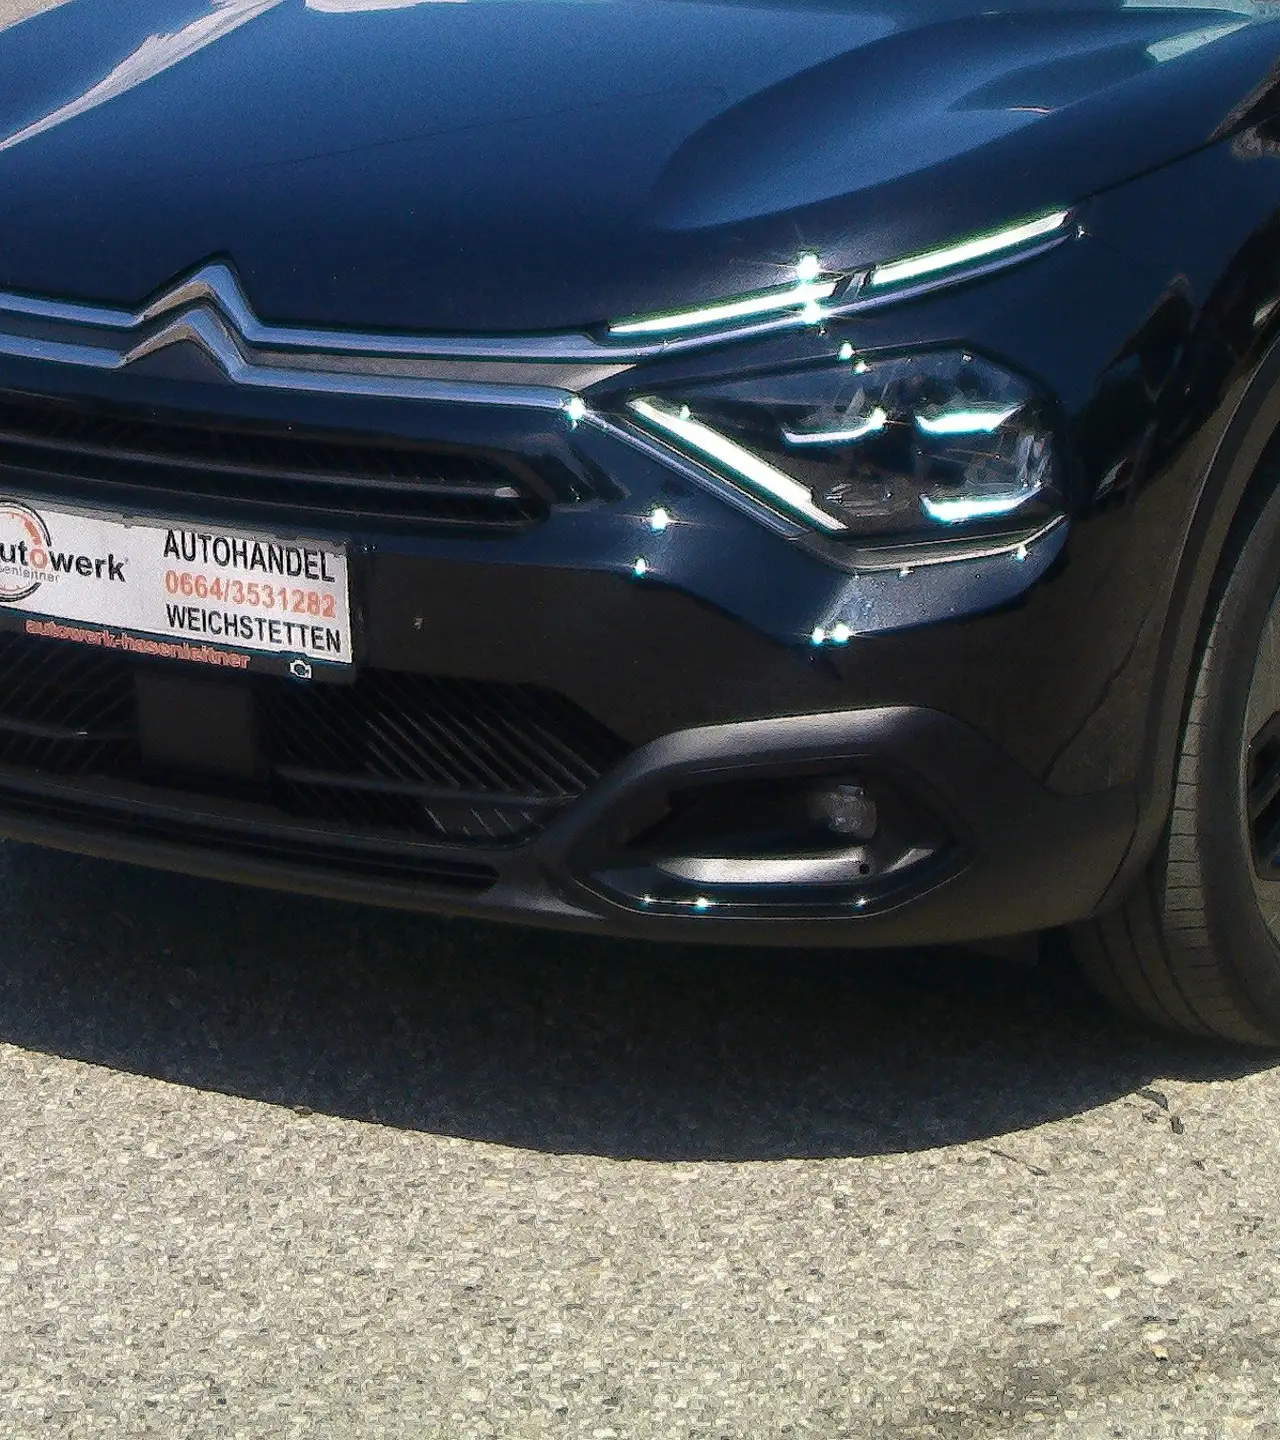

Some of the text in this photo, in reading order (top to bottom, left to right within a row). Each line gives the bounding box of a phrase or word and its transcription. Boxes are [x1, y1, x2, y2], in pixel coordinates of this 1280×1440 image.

[163, 528, 336, 583] AUTOHANDEL
[164, 568, 337, 619] 0664/3531282
[24, 619, 251, 670] autowerk-hasenleitner
[165, 603, 341, 653] WEICHSTETTEN
